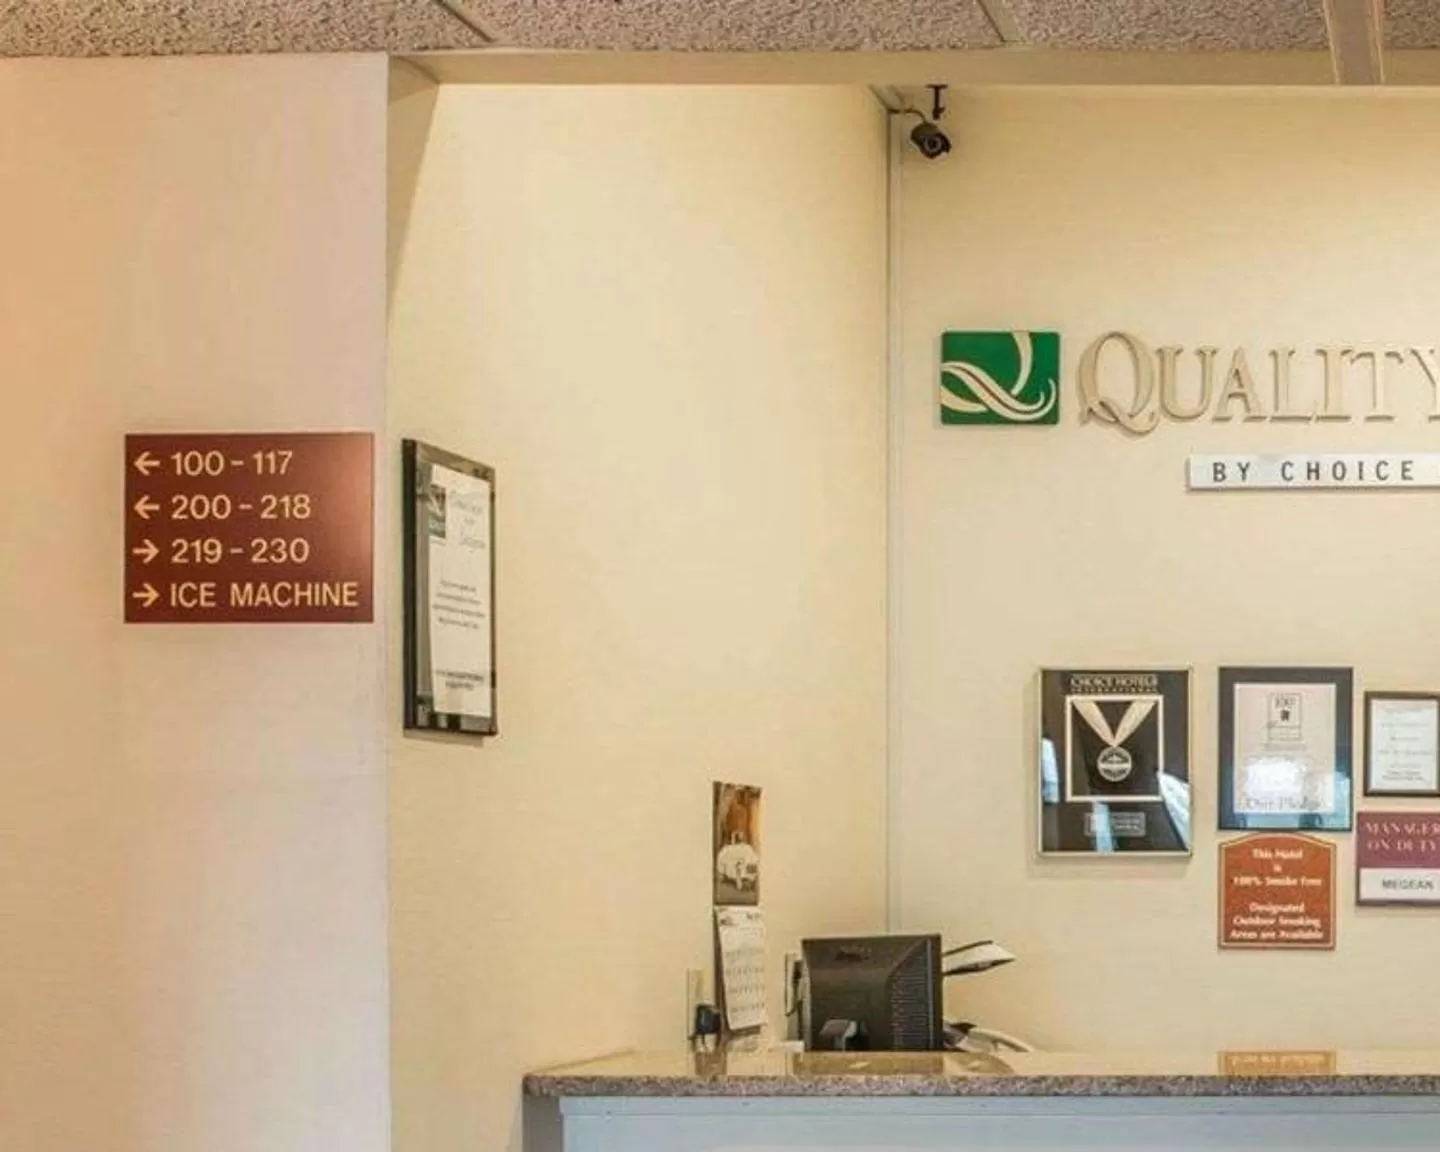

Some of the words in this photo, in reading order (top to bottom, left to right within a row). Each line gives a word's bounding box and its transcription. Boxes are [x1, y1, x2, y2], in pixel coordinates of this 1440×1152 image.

[171, 450, 224, 475] 100
[253, 450, 293, 475] 117
[1212, 461, 1252, 483] BY
[1280, 460, 1415, 482] CHOICE
[171, 494, 231, 519] 200
[260, 494, 311, 519] 218
[171, 538, 222, 563] 219
[251, 538, 309, 563] 230
[170, 582, 216, 607] ICE
[230, 582, 358, 607] MACHINE
[1366, 839, 1391, 852] ON
[1396, 839, 1438, 852] DUTY
